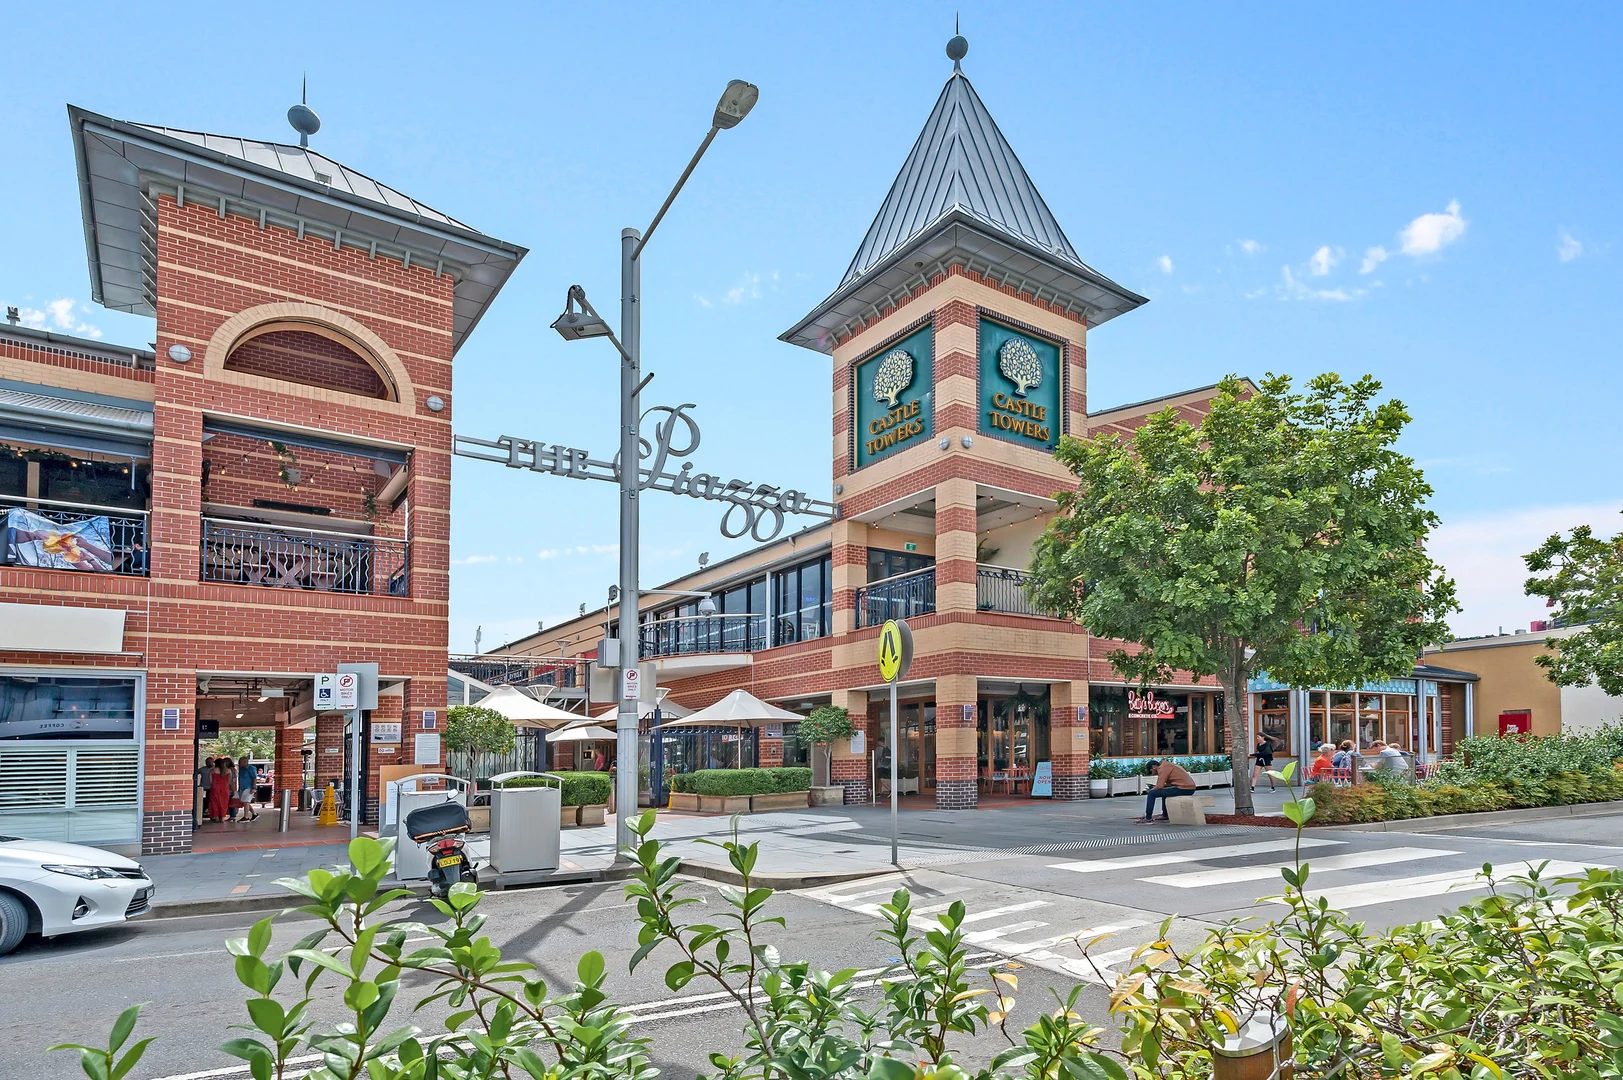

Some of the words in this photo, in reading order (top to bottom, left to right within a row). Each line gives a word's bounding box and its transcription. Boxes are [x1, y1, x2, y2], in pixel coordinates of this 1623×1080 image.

[869, 399, 919, 435] CASTLE
[993, 391, 1046, 421] CASTLE
[865, 417, 924, 455] TOWERS
[988, 411, 1050, 441] TOWERS
[498, 435, 588, 480] THE
[613, 403, 814, 543] Piazza
[321, 676, 330, 685] P
[1128, 690, 1147, 714] Betty's
[1147, 691, 1175, 716] Burgers
